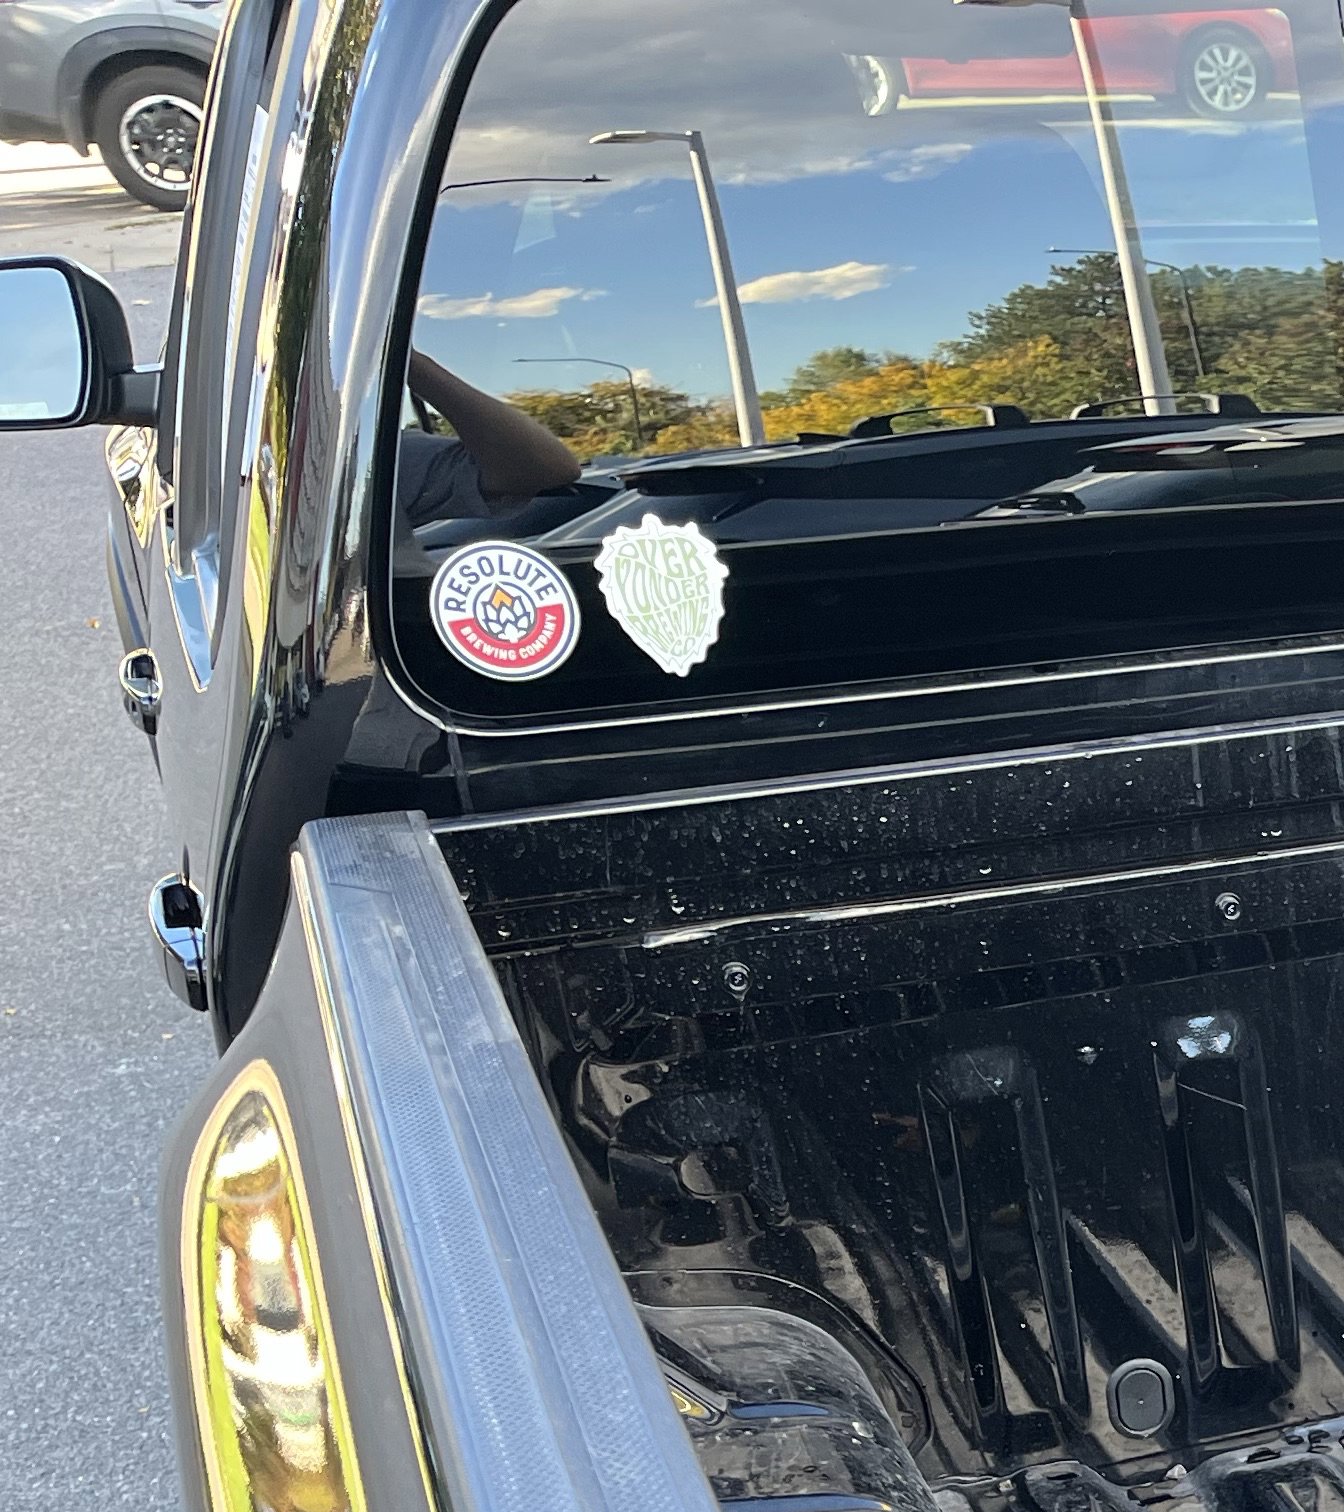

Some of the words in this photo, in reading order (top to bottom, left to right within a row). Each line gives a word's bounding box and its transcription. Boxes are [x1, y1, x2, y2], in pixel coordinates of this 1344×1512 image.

[444, 554, 558, 613] RESOLUTE
[615, 557, 710, 614] YONDER
[618, 536, 707, 578] OVER
[460, 625, 516, 661] BREWING
[519, 613, 557, 658] COMPANY
[626, 596, 709, 653] BREWING
